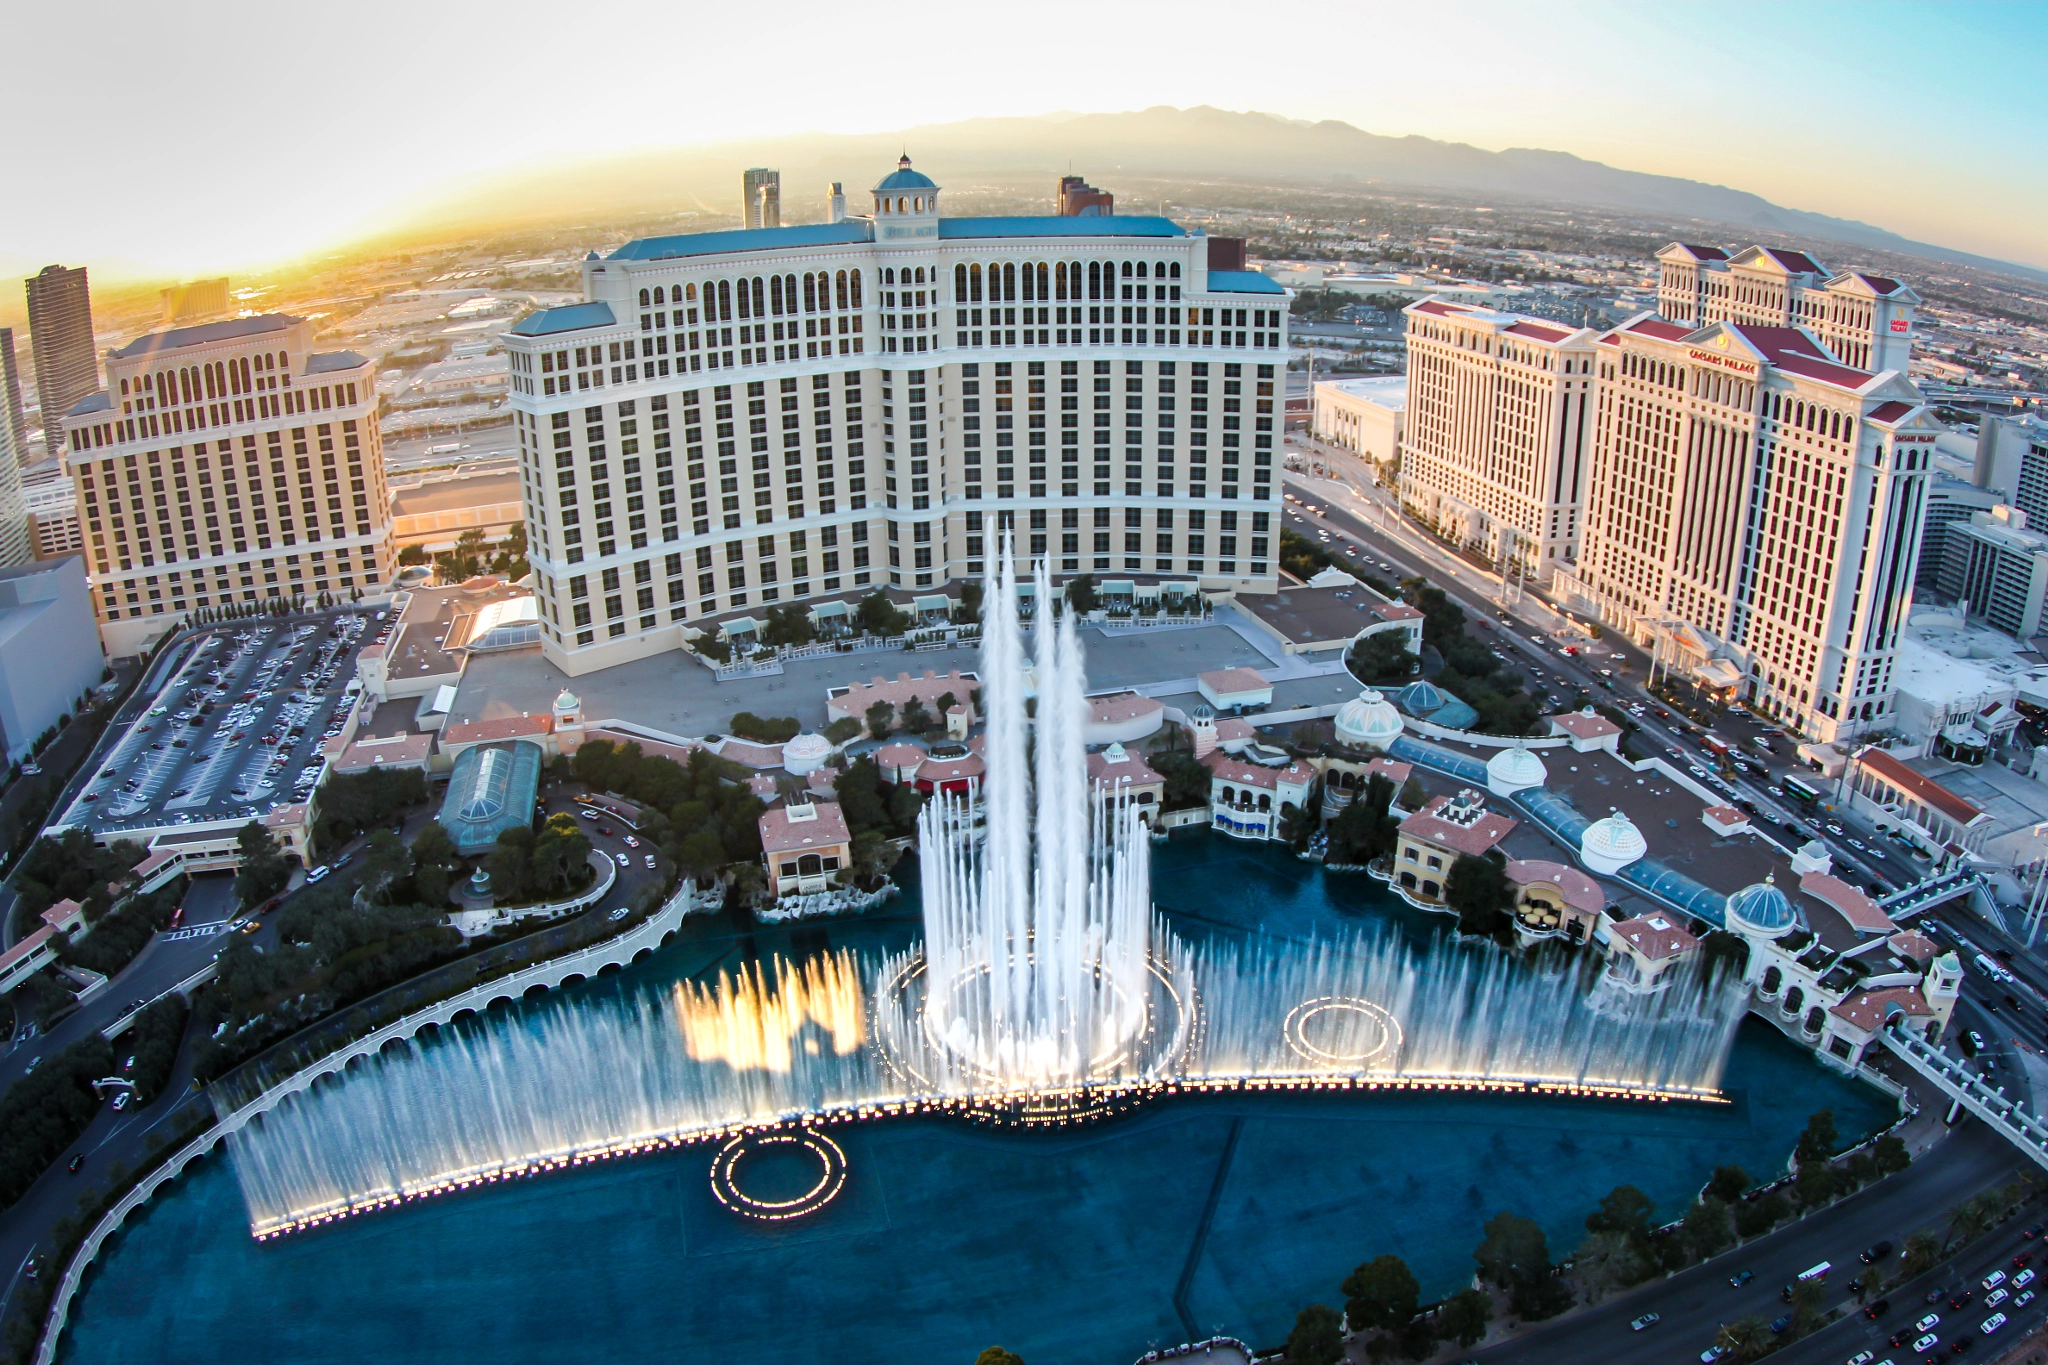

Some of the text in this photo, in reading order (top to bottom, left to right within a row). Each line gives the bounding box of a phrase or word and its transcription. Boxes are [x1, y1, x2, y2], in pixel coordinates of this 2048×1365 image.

[1689, 349, 1755, 375] CAESARS PALACE
[1894, 435, 1936, 443] CAESARS PALACE
